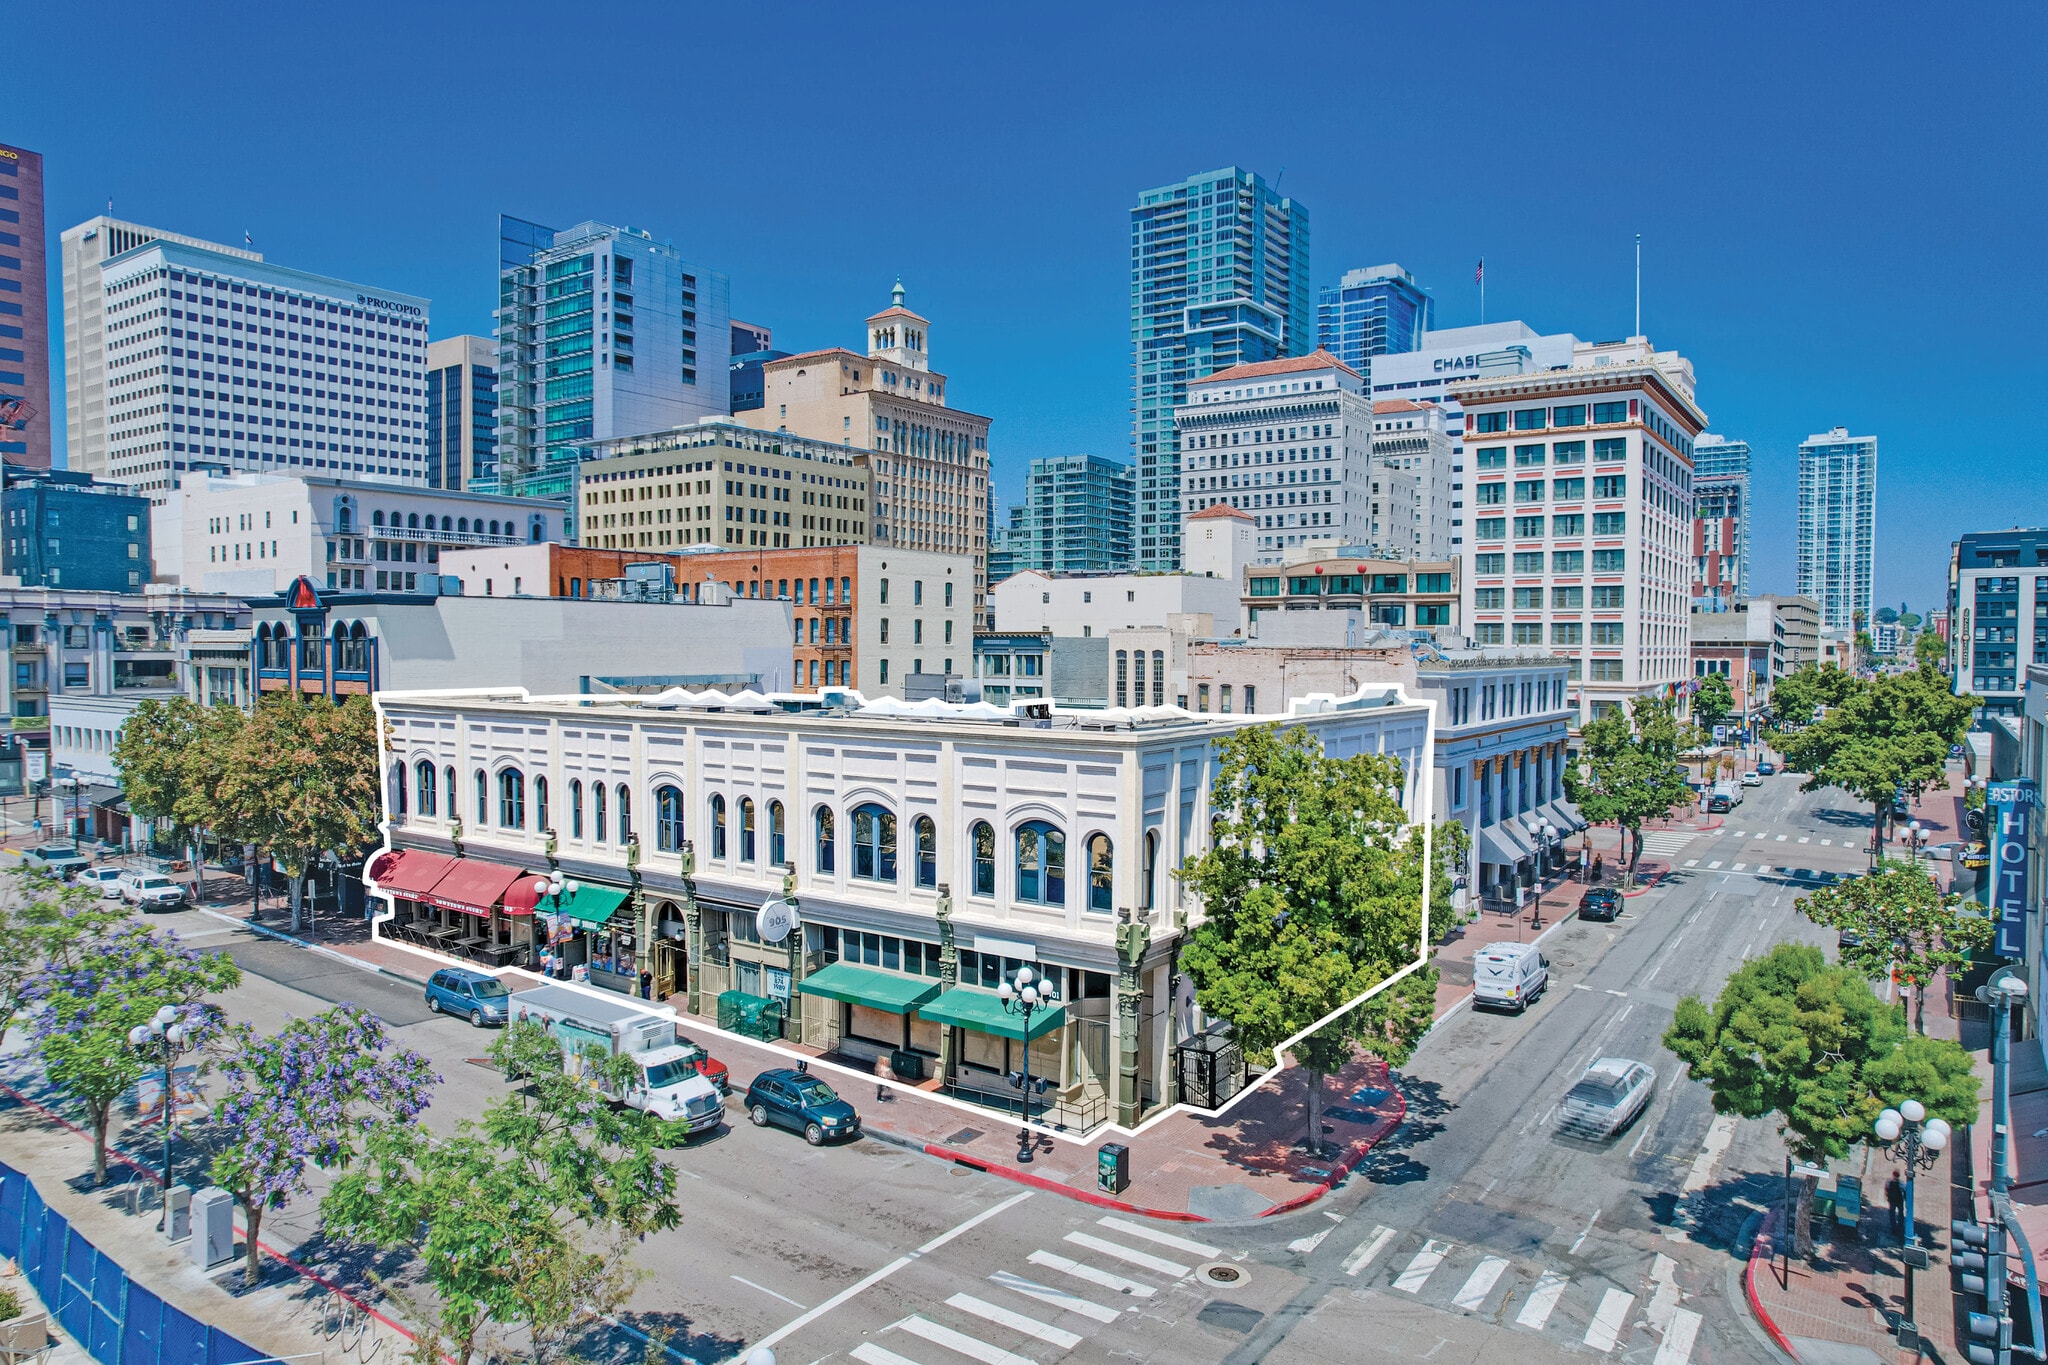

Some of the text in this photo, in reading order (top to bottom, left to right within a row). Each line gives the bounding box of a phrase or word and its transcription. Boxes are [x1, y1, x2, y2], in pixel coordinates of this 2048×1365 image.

[366, 296, 421, 316] PROCOPIO
[1992, 787, 2034, 803] ASTOR
[2001, 811, 2025, 952] HOTEL
[769, 915, 787, 927] 905
